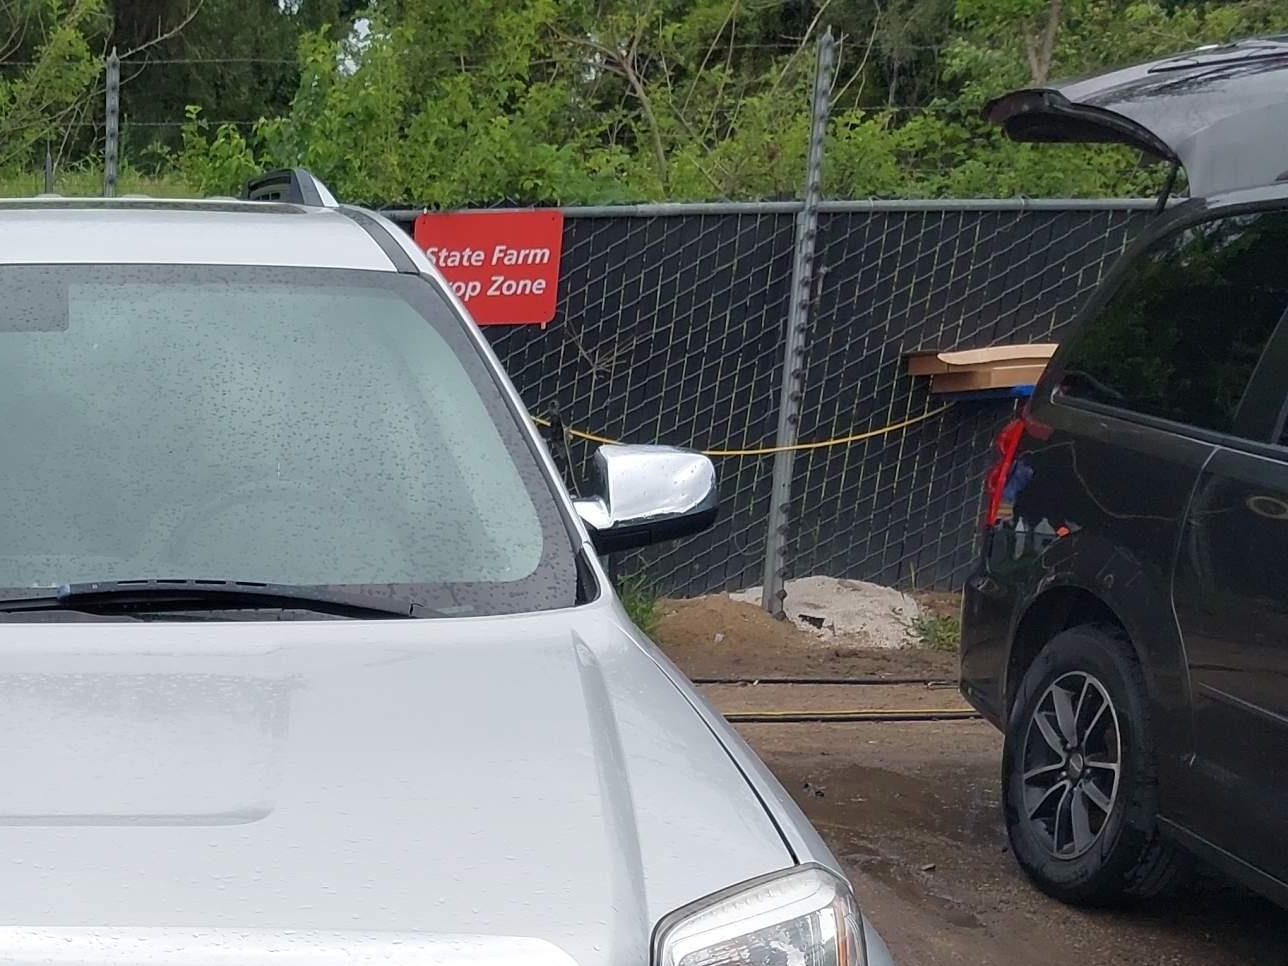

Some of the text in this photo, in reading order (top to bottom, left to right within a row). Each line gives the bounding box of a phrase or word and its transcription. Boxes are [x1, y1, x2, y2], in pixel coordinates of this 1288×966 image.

[425, 245, 550, 268] State Farm
[450, 275, 546, 302] op Zone
